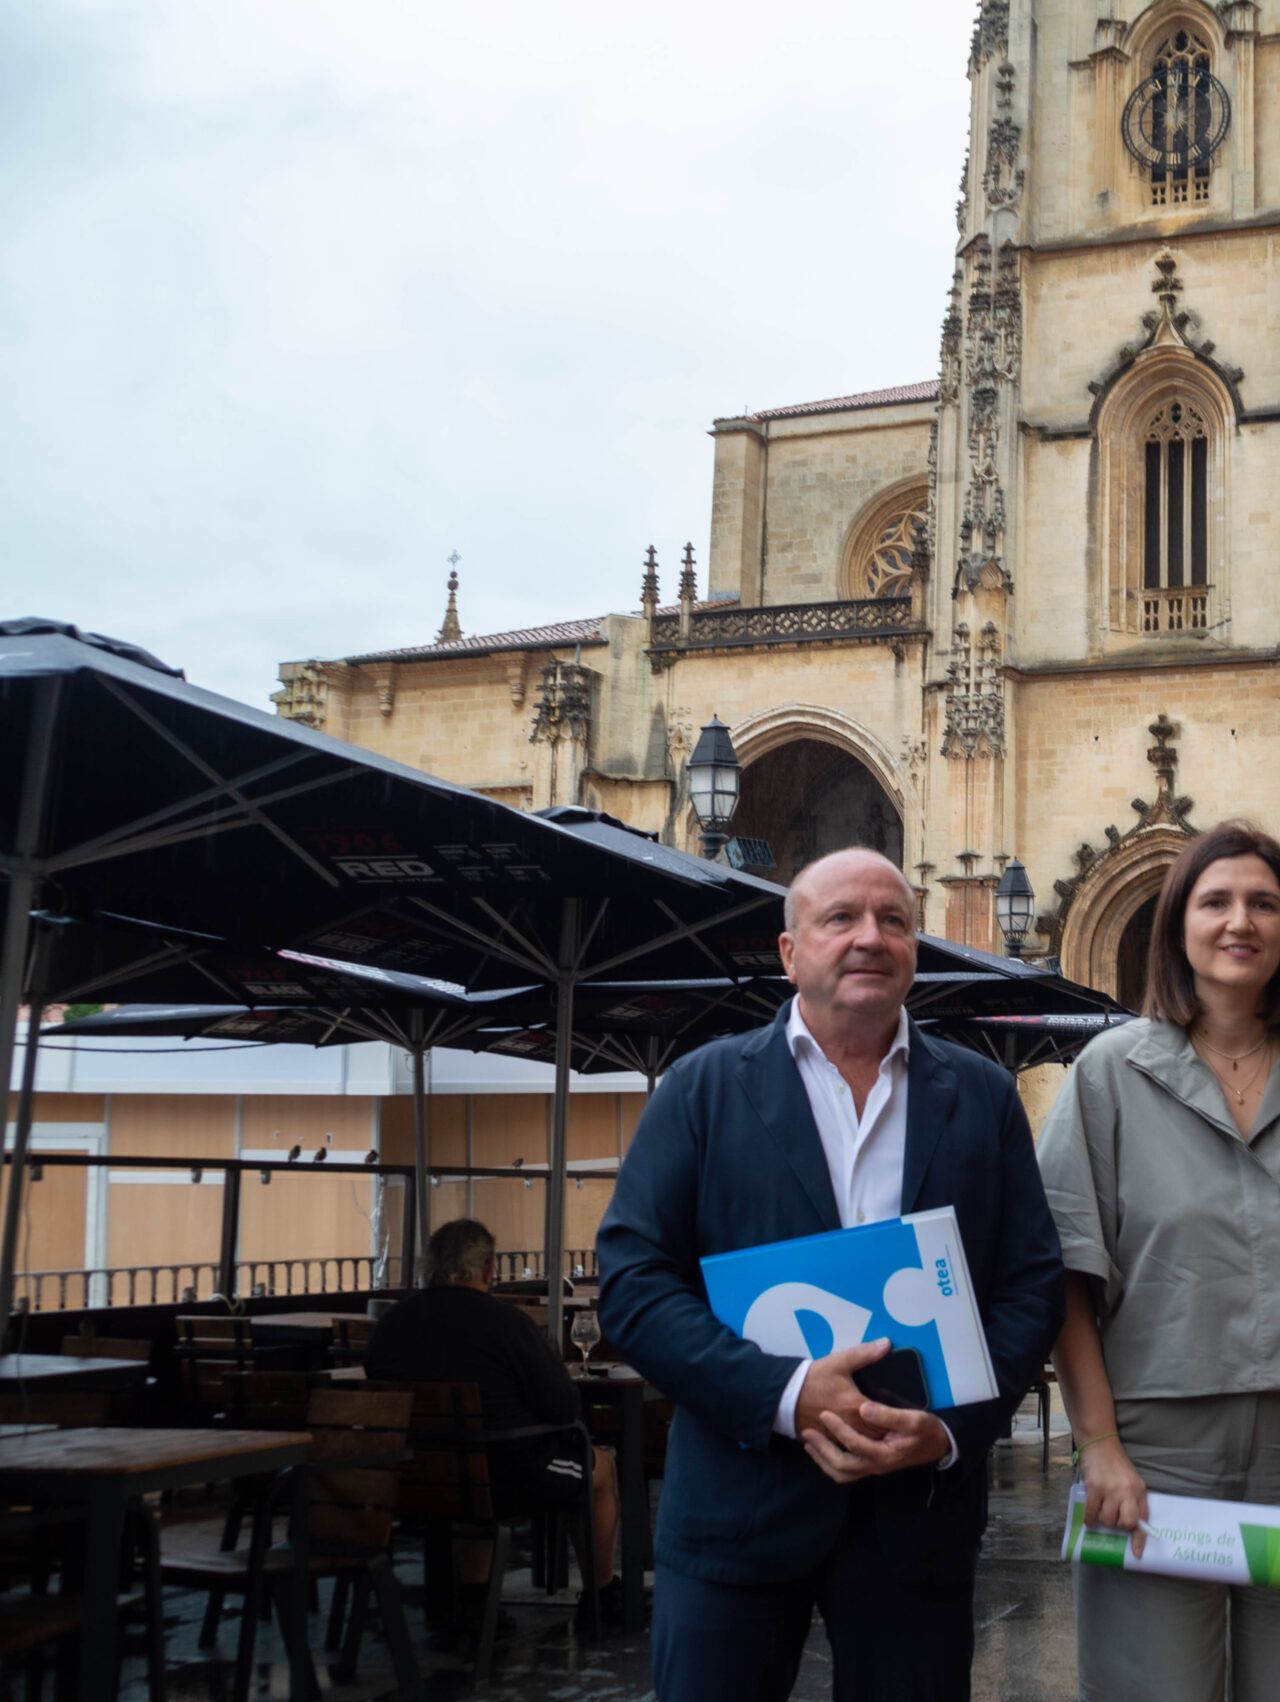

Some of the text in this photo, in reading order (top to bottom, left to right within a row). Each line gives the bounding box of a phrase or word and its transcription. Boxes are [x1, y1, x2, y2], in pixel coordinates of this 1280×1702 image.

[336, 861, 436, 878] RED
[935, 1258, 954, 1297] otea
[1217, 1529, 1237, 1547] de
[1173, 1547, 1234, 1568] Asturias
